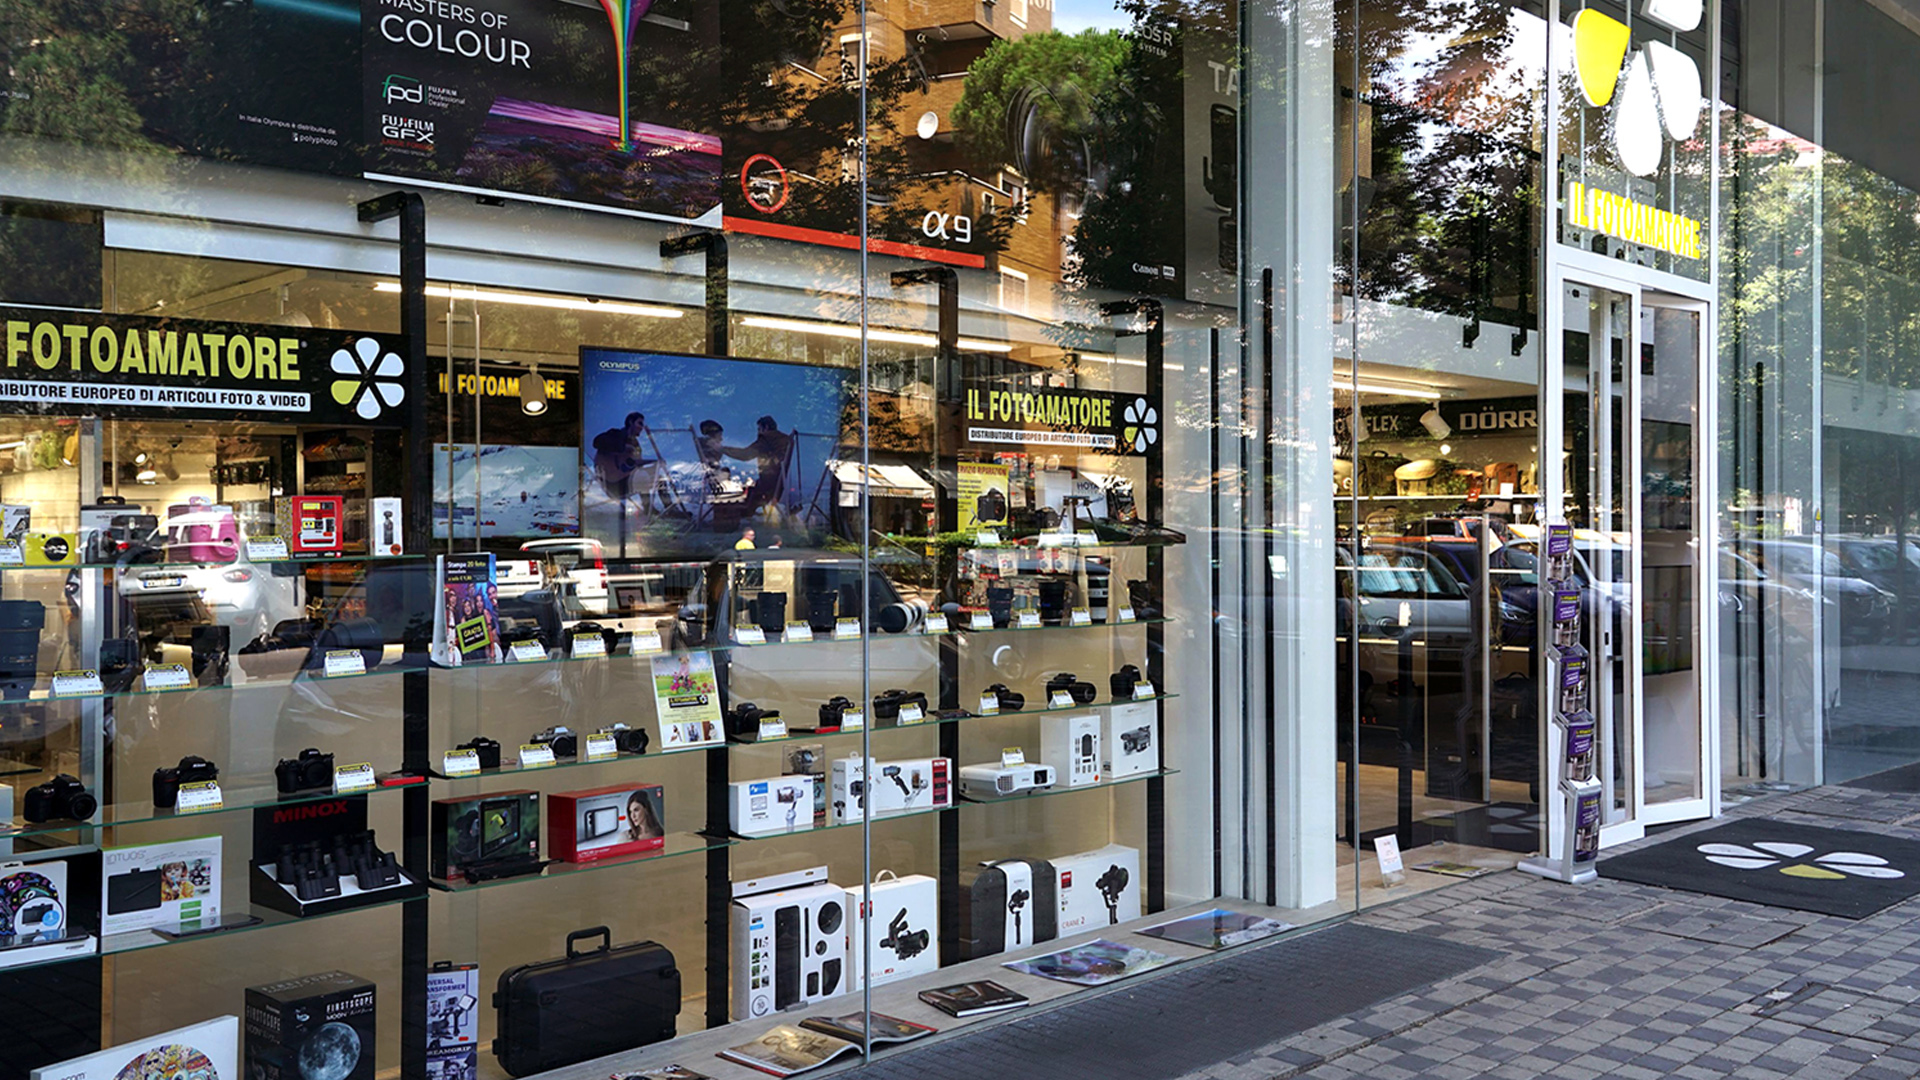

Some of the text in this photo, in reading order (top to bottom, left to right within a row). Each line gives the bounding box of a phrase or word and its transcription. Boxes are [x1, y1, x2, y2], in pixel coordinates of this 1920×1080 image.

[480, 11, 508, 29] OF
[380, 13, 531, 69] COLOUR
[428, 86, 457, 96] FUJIFILM
[428, 93, 466, 104] Professional
[428, 100, 449, 108] Dealer
[247, 116, 261, 124] Italia
[262, 117, 291, 128] Olympus
[382, 114, 434, 131] FUJIFILM
[299, 134, 338, 147] polyphoto
[382, 126, 434, 144] GFX
[1570, 181, 1700, 260] IL FOTOAMATORE
[1132, 262, 1159, 276] Canon
[6, 320, 301, 381] FOTOAMATORE
[599, 360, 640, 371] OLYMPUS
[457, 374, 566, 400] FOTOAMRE
[71, 385, 136, 401] EUROPEO
[140, 389, 153, 401] DI
[157, 390, 217, 404] ARTICOLI
[220, 392, 253, 406] FOTO
[256, 394, 267, 406] &
[270, 395, 307, 408] VIDEO
[968, 388, 1112, 428] IL FOTOAMATORE
[1459, 405, 1538, 431] DÖRR
[970, 429, 1014, 441] DISTRIBUTORE
[1015, 431, 1042, 442] EUROPEO
[1043, 433, 1049, 442] DI
[1050, 433, 1075, 443] ARTICOLI
[1076, 435, 1091, 444] FOTO
[273, 800, 348, 824] MINOX
[1061, 916, 1086, 929] CRANE 2
[326, 996, 374, 1013] FIRSTSCOPE
